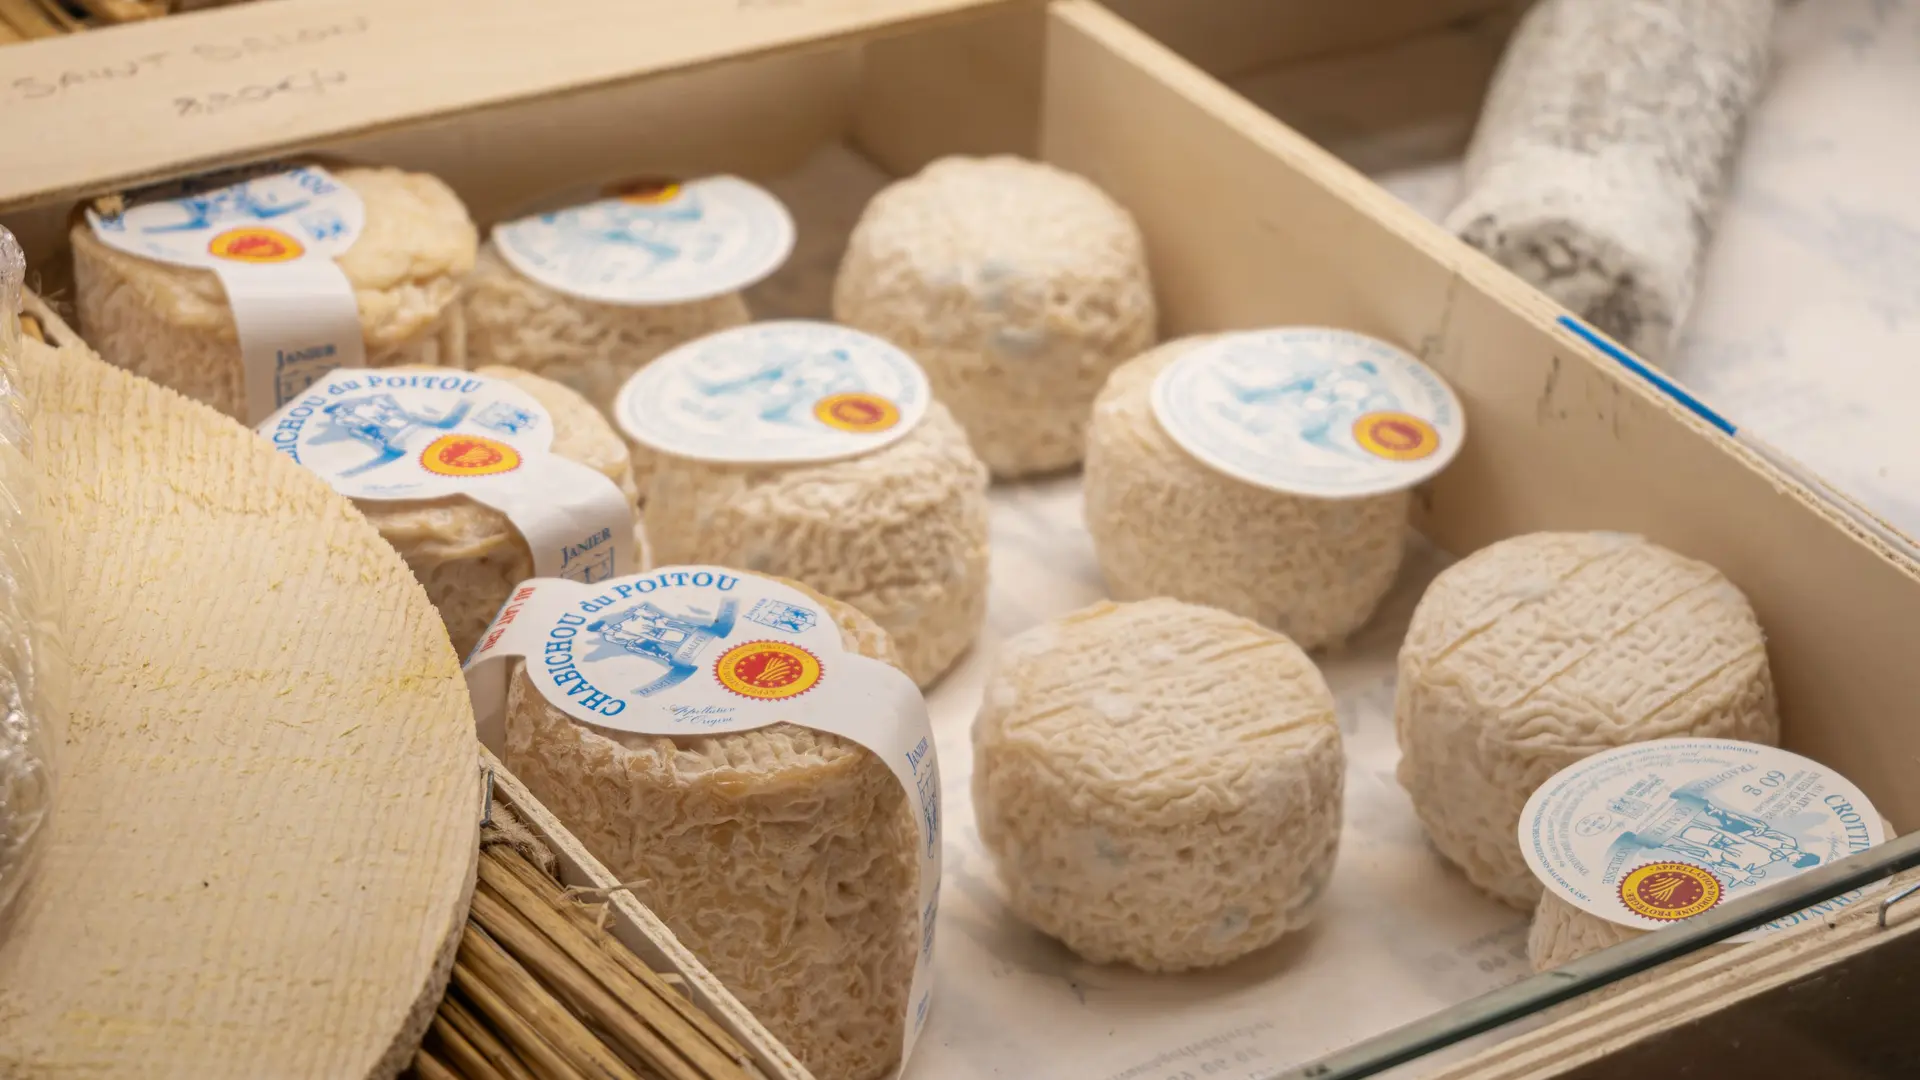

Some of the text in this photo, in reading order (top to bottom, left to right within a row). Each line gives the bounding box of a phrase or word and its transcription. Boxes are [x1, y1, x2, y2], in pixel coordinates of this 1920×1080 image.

[328, 379, 362, 396] du
[365, 375, 484, 393] POITOU
[560, 527, 611, 568] JANIER
[496, 603, 524, 626] LAIT
[544, 572, 740, 717] CHABICHOU du POITOU
[1742, 784, 1762, 796] g
[1759, 770, 1786, 788] 60
[1655, 865, 1715, 890] APPELLATION
